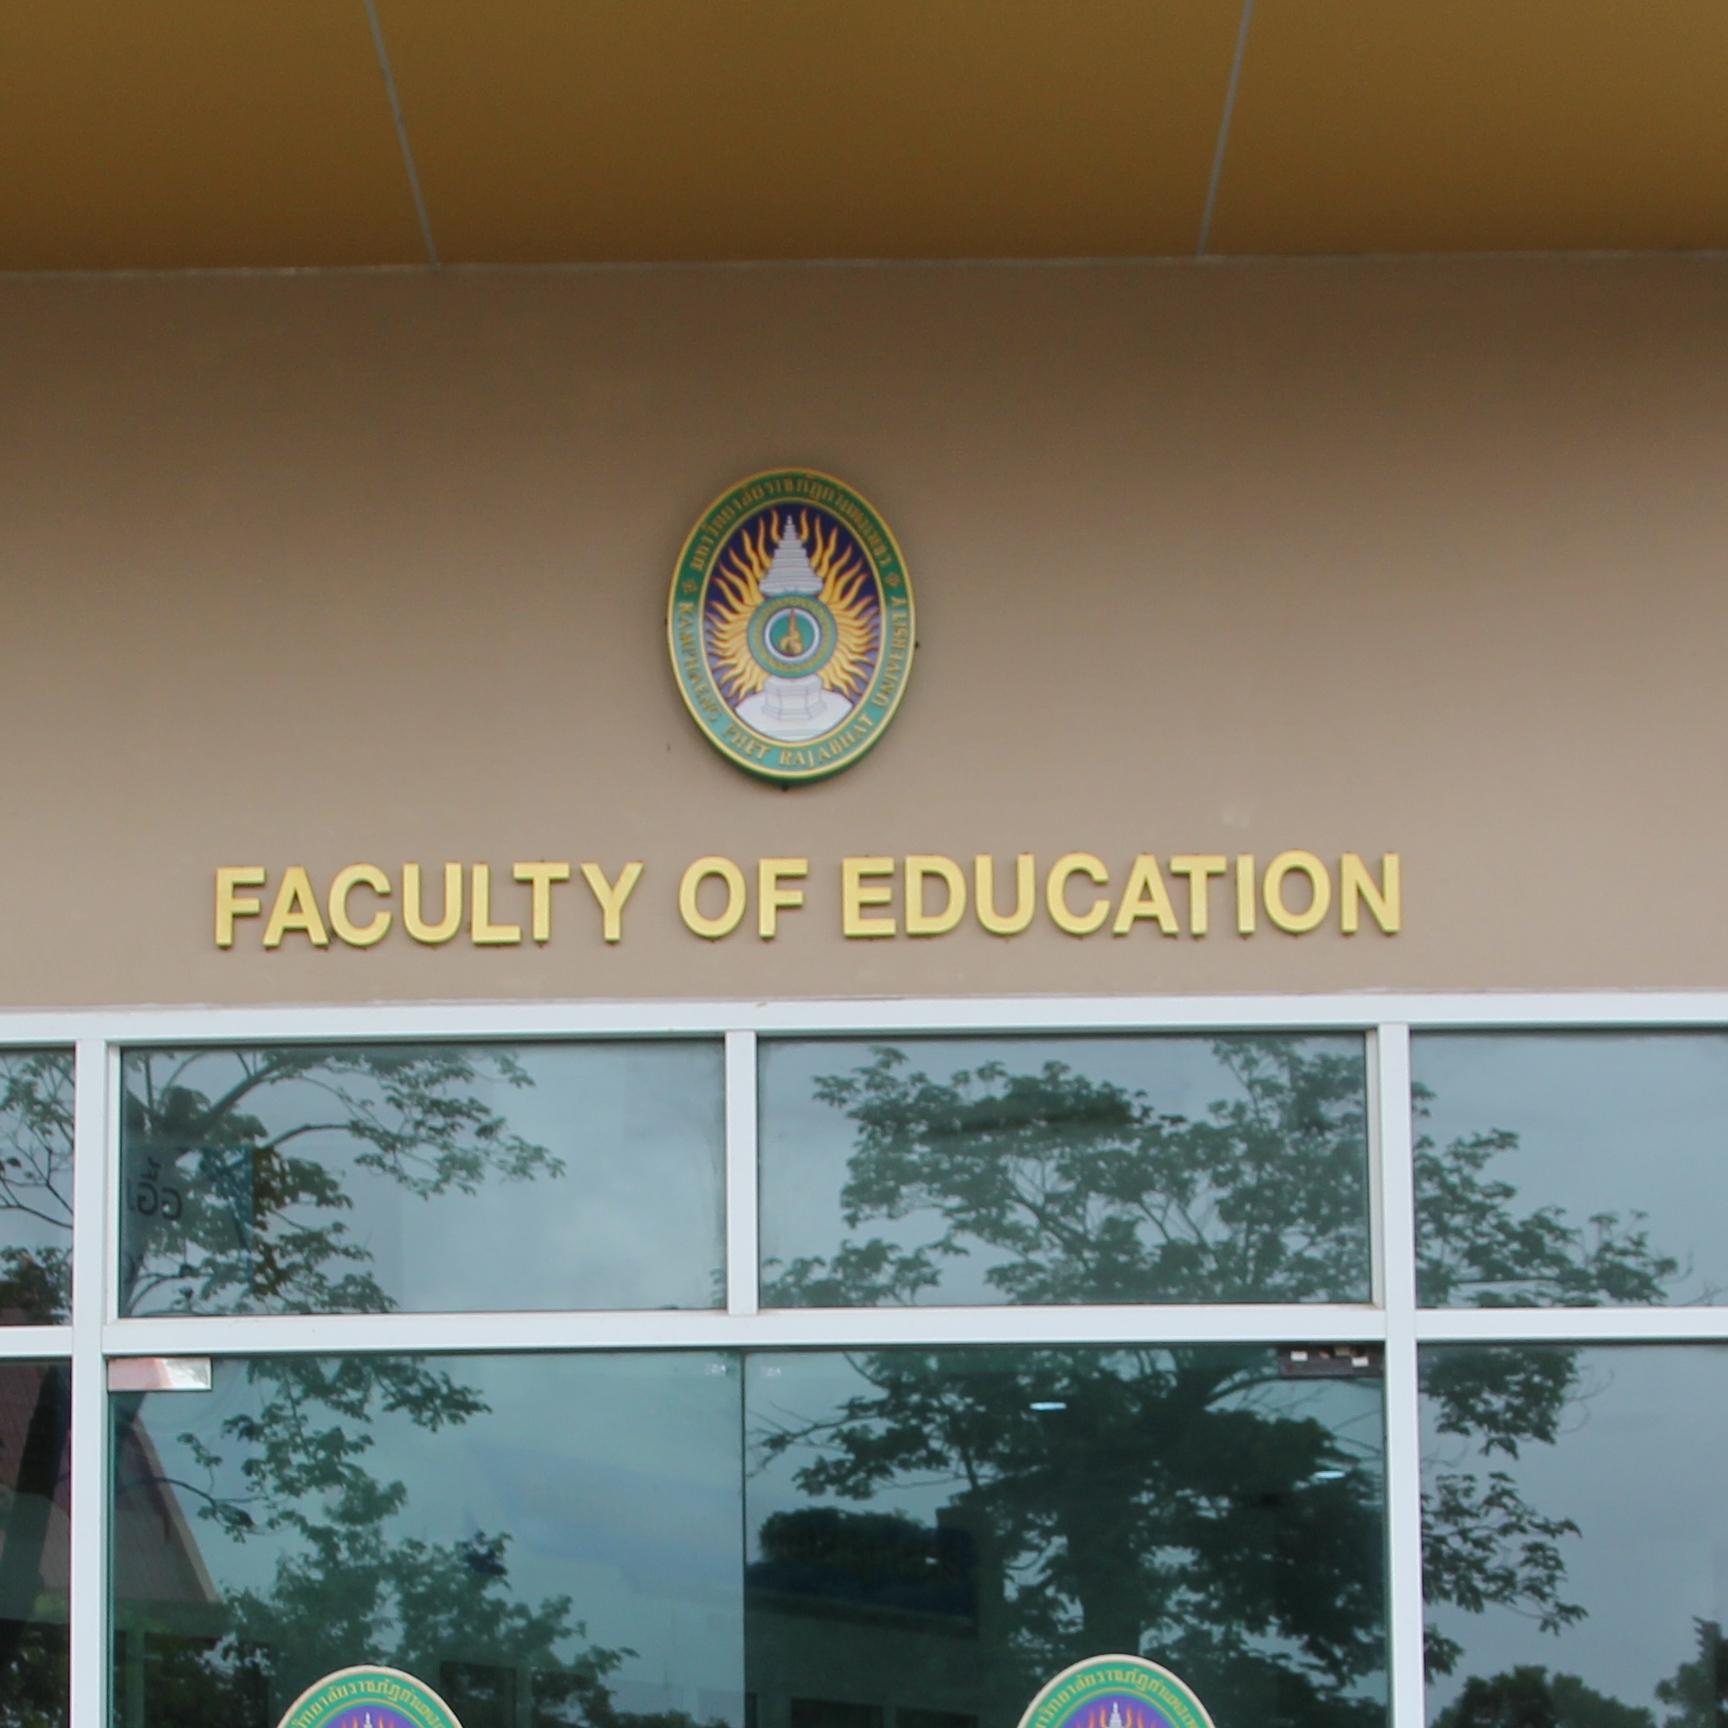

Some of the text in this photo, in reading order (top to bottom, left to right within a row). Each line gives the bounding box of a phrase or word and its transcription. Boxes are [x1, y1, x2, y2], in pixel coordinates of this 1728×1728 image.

[725, 723, 771, 761] PHET
[778, 713, 875, 768] RAJABHAT
[872, 596, 908, 708] UNIVERSITY
[214, 850, 1403, 949] FACULTY OF EDUCATION
